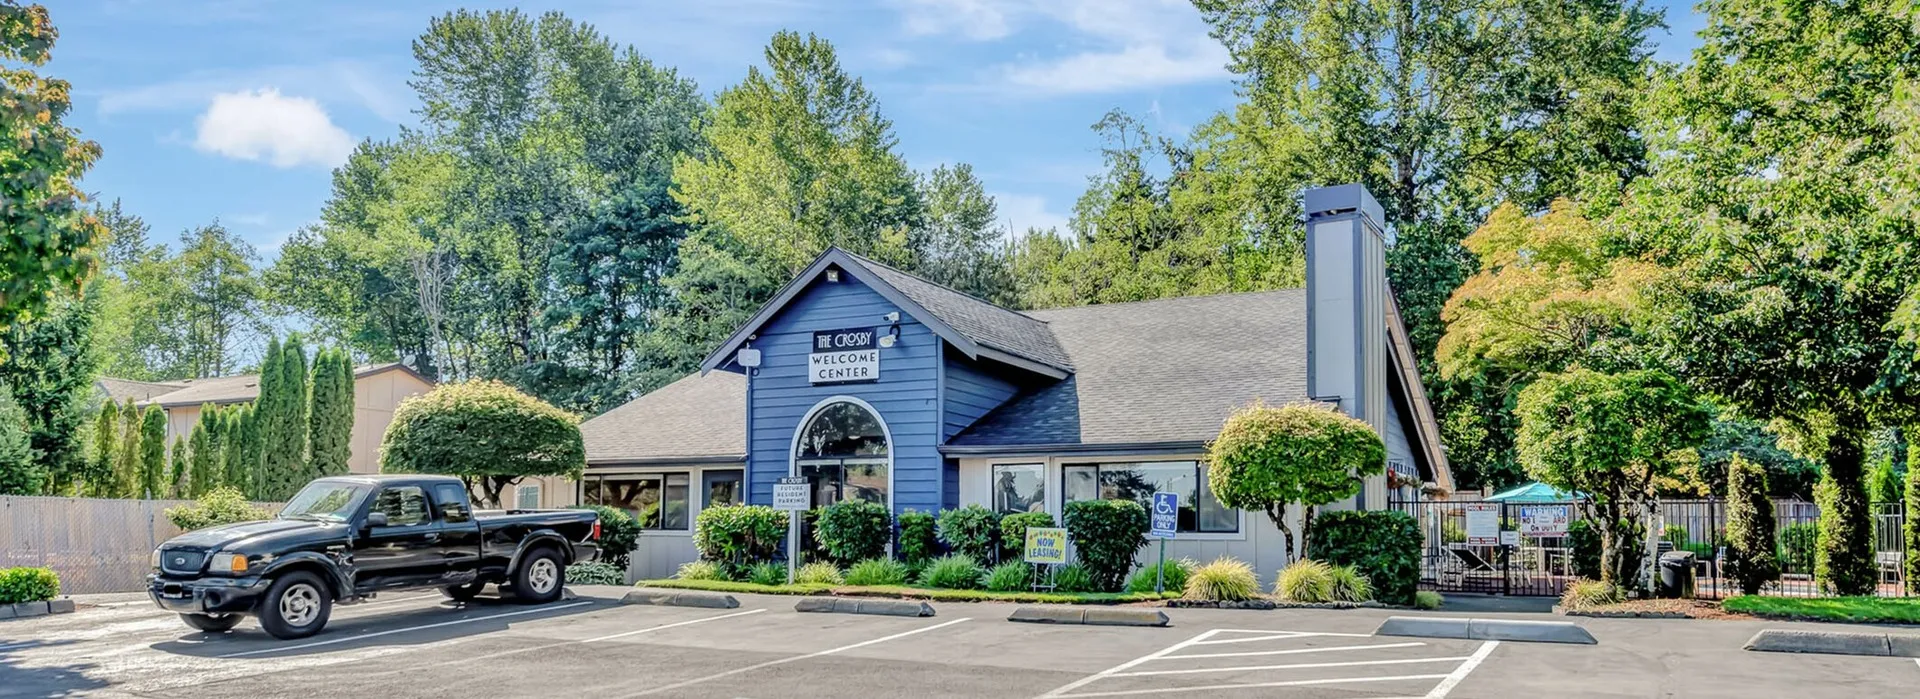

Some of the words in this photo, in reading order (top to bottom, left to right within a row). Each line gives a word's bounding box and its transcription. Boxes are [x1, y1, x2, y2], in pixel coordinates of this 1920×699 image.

[817, 335, 831, 348] THE
[835, 332, 872, 347] CROSBY
[812, 352, 876, 365] WELCOME
[819, 367, 868, 379] CENTER
[1037, 538, 1055, 546] NOW
[1029, 548, 1062, 559] LEASING!
